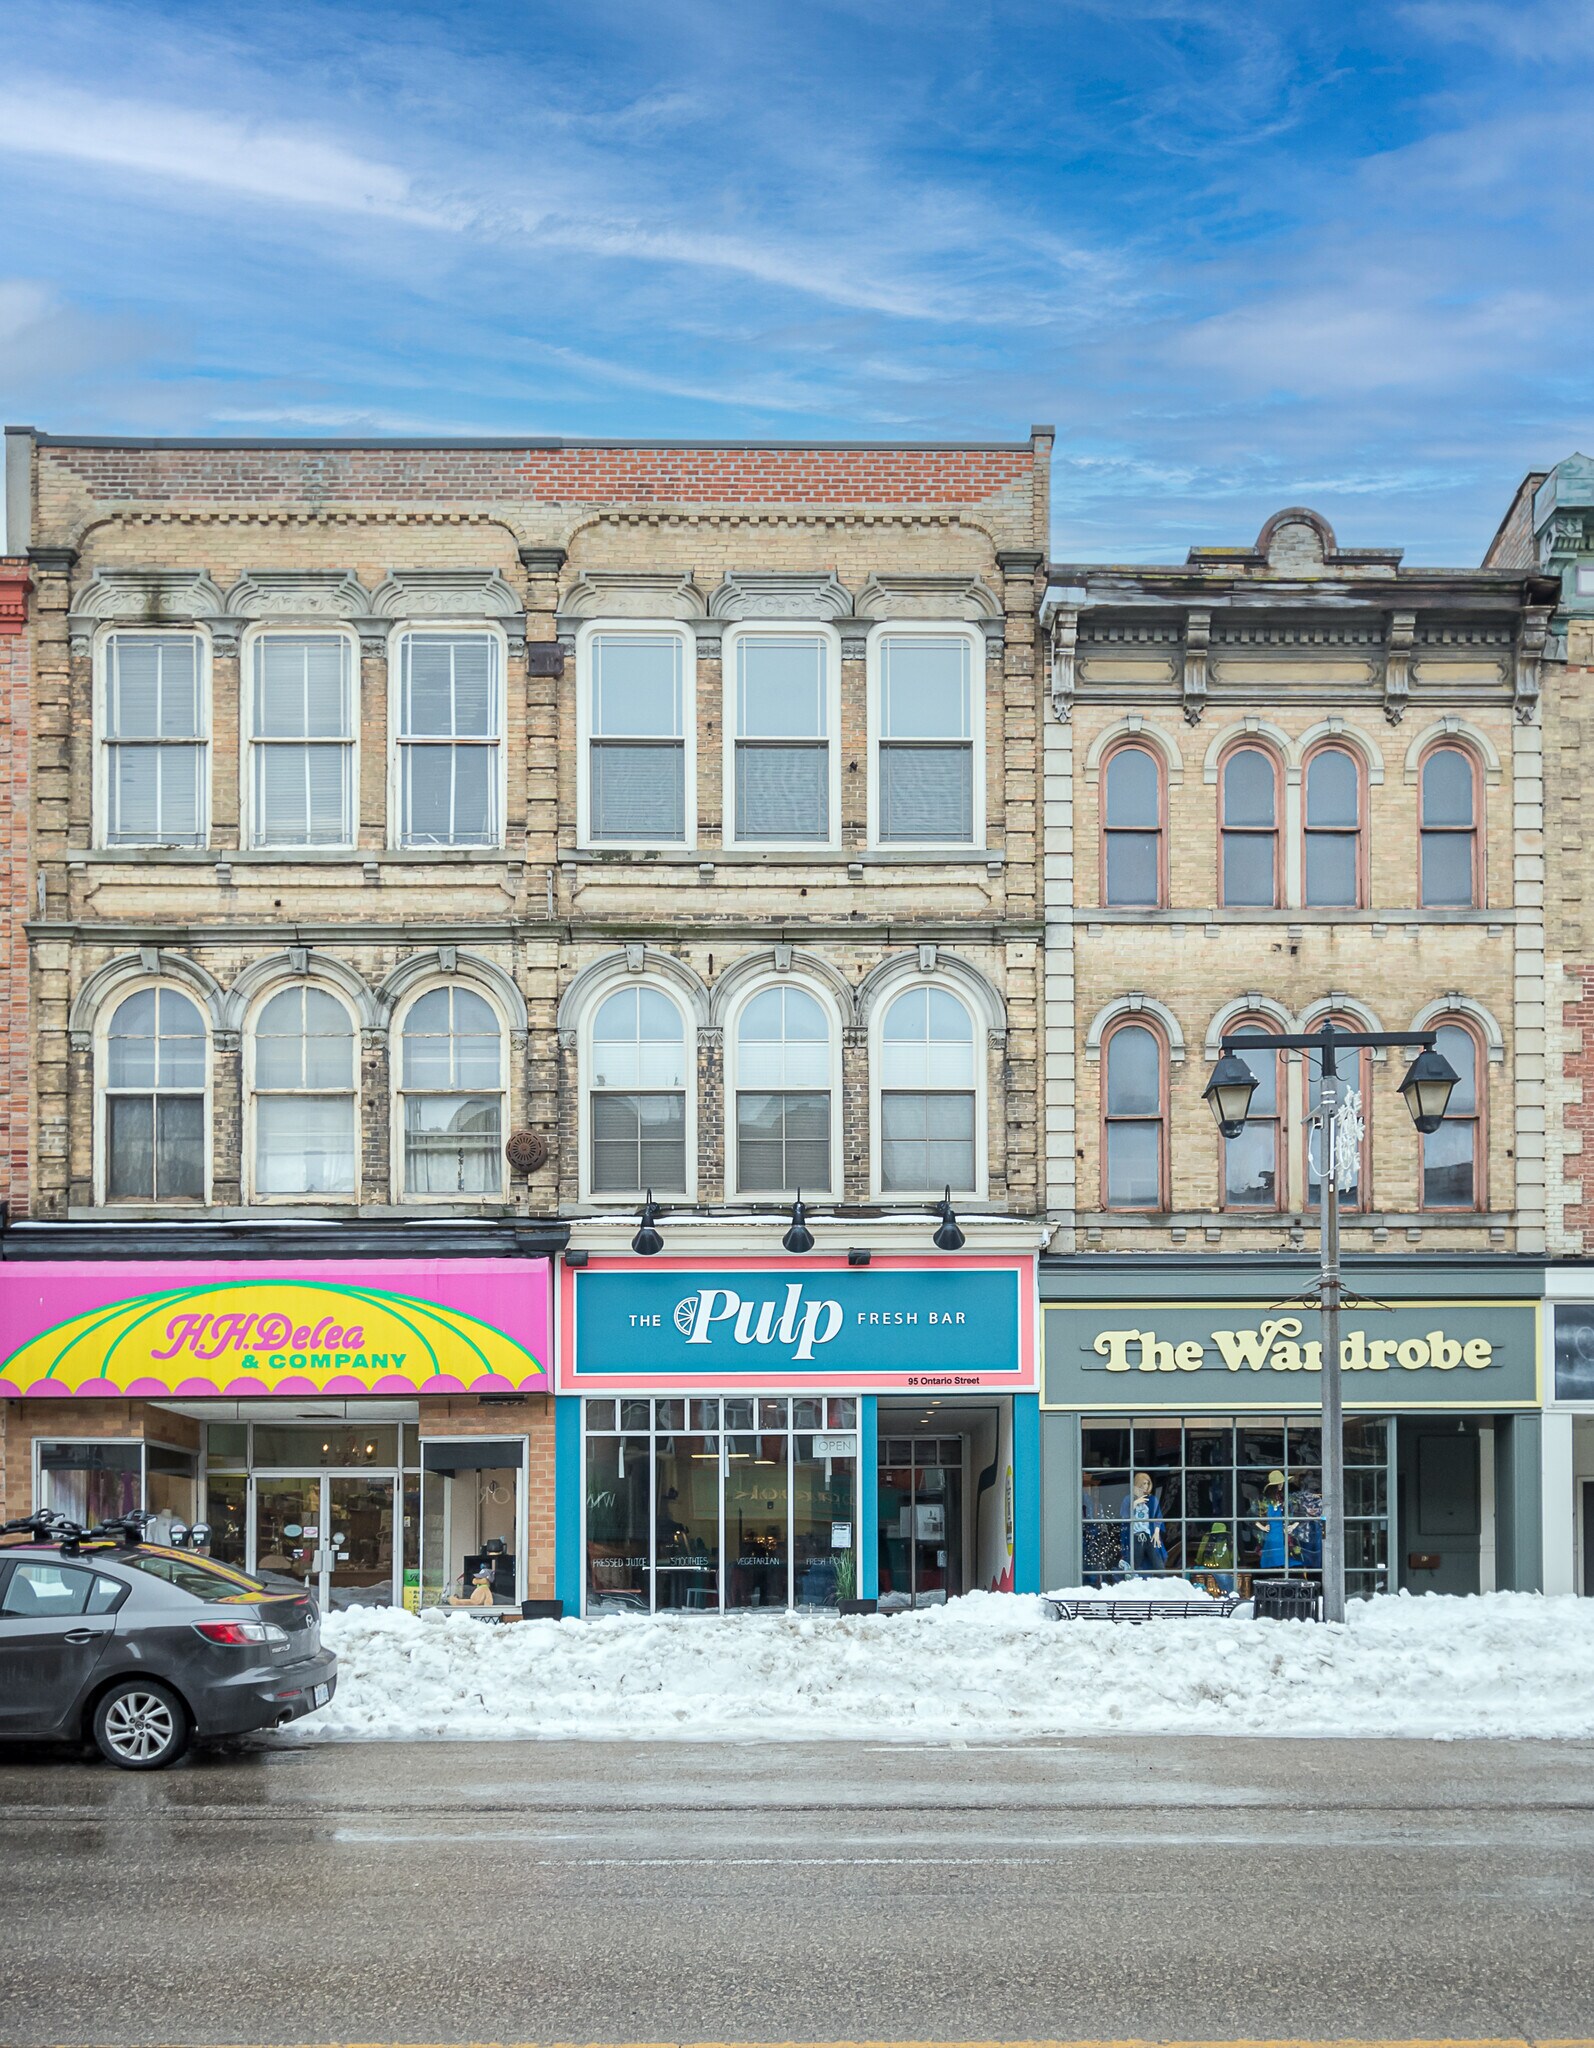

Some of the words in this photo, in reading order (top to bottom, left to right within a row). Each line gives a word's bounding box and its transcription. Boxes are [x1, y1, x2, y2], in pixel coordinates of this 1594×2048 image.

[629, 1314, 661, 1327] THE
[686, 1283, 844, 1360] Pulp
[857, 1311, 918, 1325] FRESH
[929, 1312, 966, 1325] BAR
[1093, 1328, 1204, 1372] The
[1210, 1317, 1493, 1372] Wardrobe
[241, 1354, 260, 1369] &
[268, 1353, 408, 1369] COMPANY
[908, 1377, 919, 1386] 95
[920, 1376, 953, 1385] Ontario
[954, 1376, 980, 1385] Street
[819, 1440, 851, 1452] OPEN
[592, 1557, 624, 1568] PRESSED
[625, 1557, 647, 1568] JUICE
[670, 1556, 709, 1566] SMOOTHIES
[736, 1557, 780, 1566] VEGETARIAN
[805, 1557, 826, 1566] FRESH
